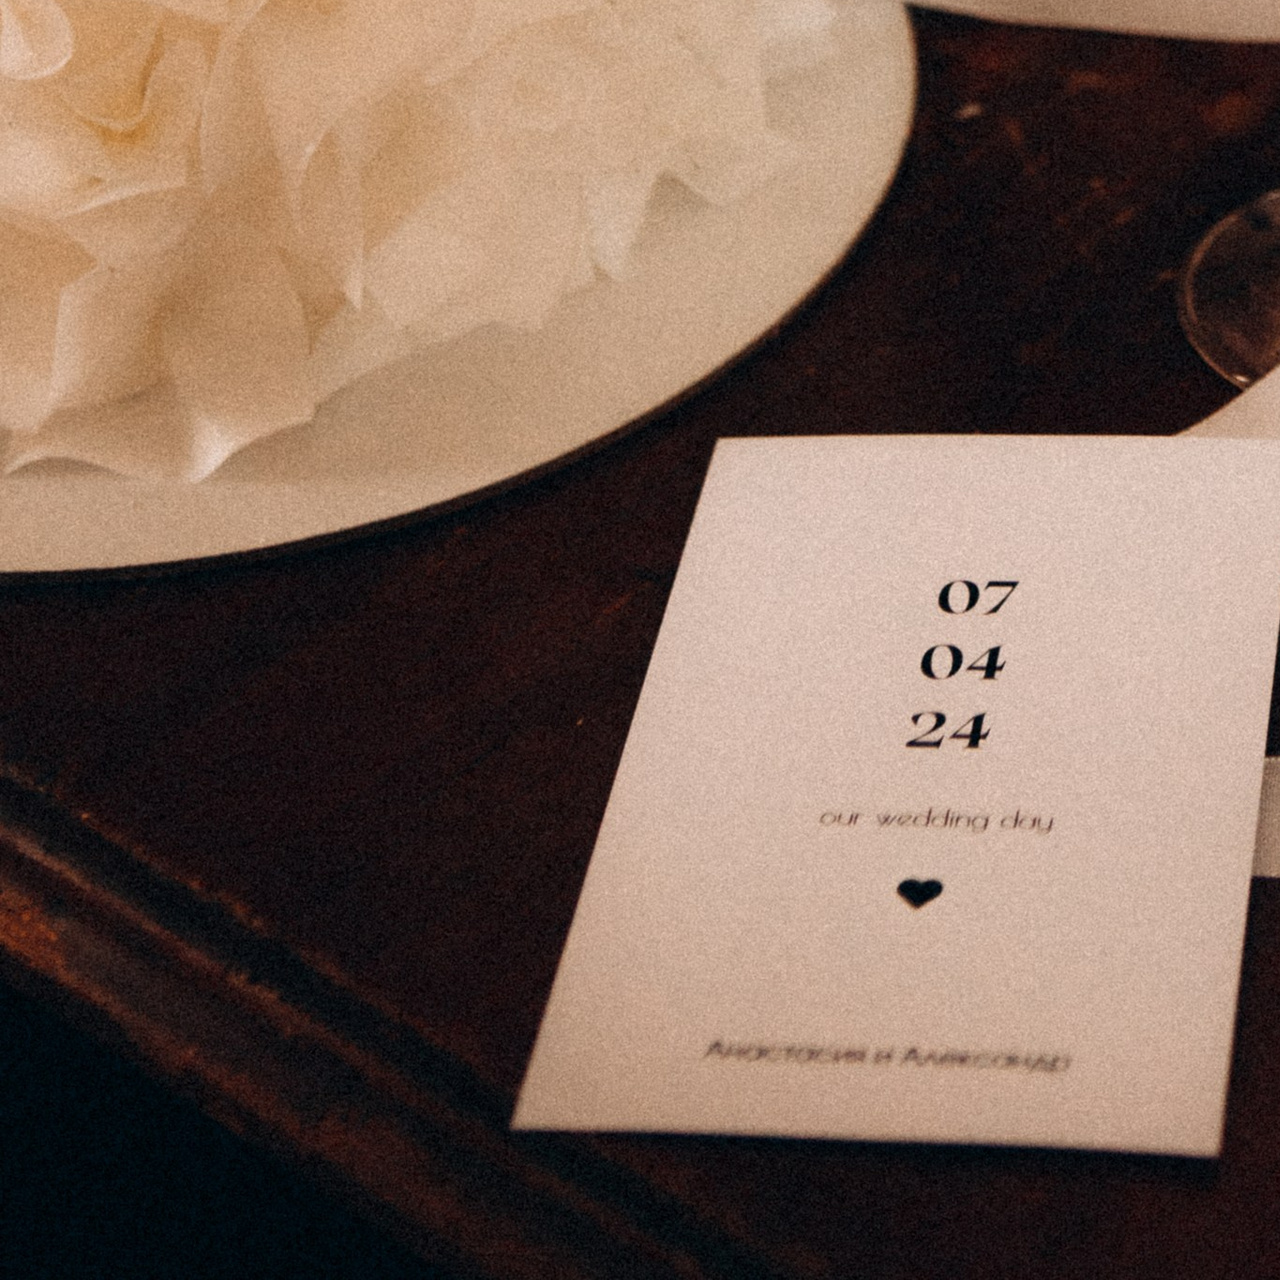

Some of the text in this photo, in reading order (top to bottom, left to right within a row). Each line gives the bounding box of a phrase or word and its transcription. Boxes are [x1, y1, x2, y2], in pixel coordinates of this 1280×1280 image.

[937, 579, 1019, 615] 07
[920, 644, 1006, 680] 04
[905, 710, 991, 749] 24
[819, 807, 1054, 834] our wedding day
